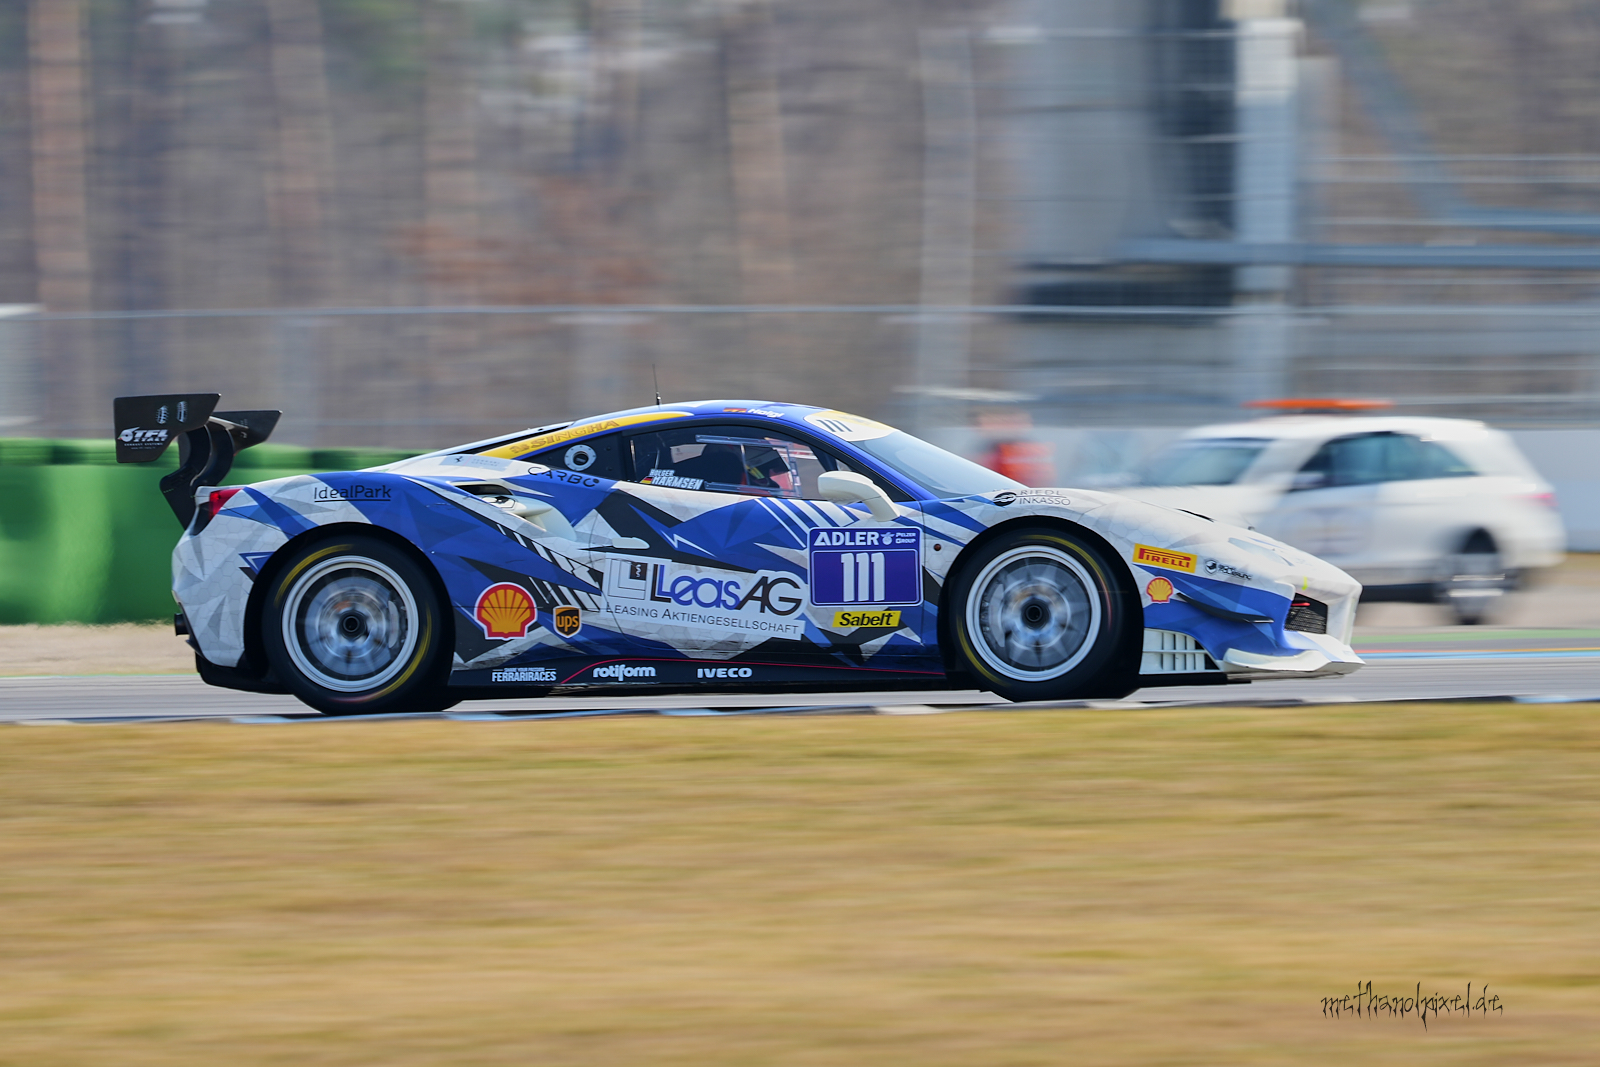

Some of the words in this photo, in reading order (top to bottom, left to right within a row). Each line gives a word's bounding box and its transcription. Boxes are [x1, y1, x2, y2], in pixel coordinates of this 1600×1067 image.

[133, 429, 169, 438] TFL
[530, 420, 620, 449] SINGHA
[651, 475, 704, 490] HARMSEN
[314, 484, 392, 499] IdealPark
[1020, 497, 1071, 506] INKASSO
[813, 531, 880, 546] ADLER
[1138, 547, 1192, 568] PIRELLI
[841, 552, 885, 602] 111
[650, 563, 803, 616] LeasAG
[557, 615, 579, 632] ups
[606, 602, 658, 619] LEASING
[661, 608, 799, 634] AKTIENGESELLSCHAFT
[839, 612, 893, 626] Sabelt
[491, 671, 557, 682] FERRARIRACES
[592, 664, 656, 682] rotiform
[697, 667, 752, 679] IVECO
